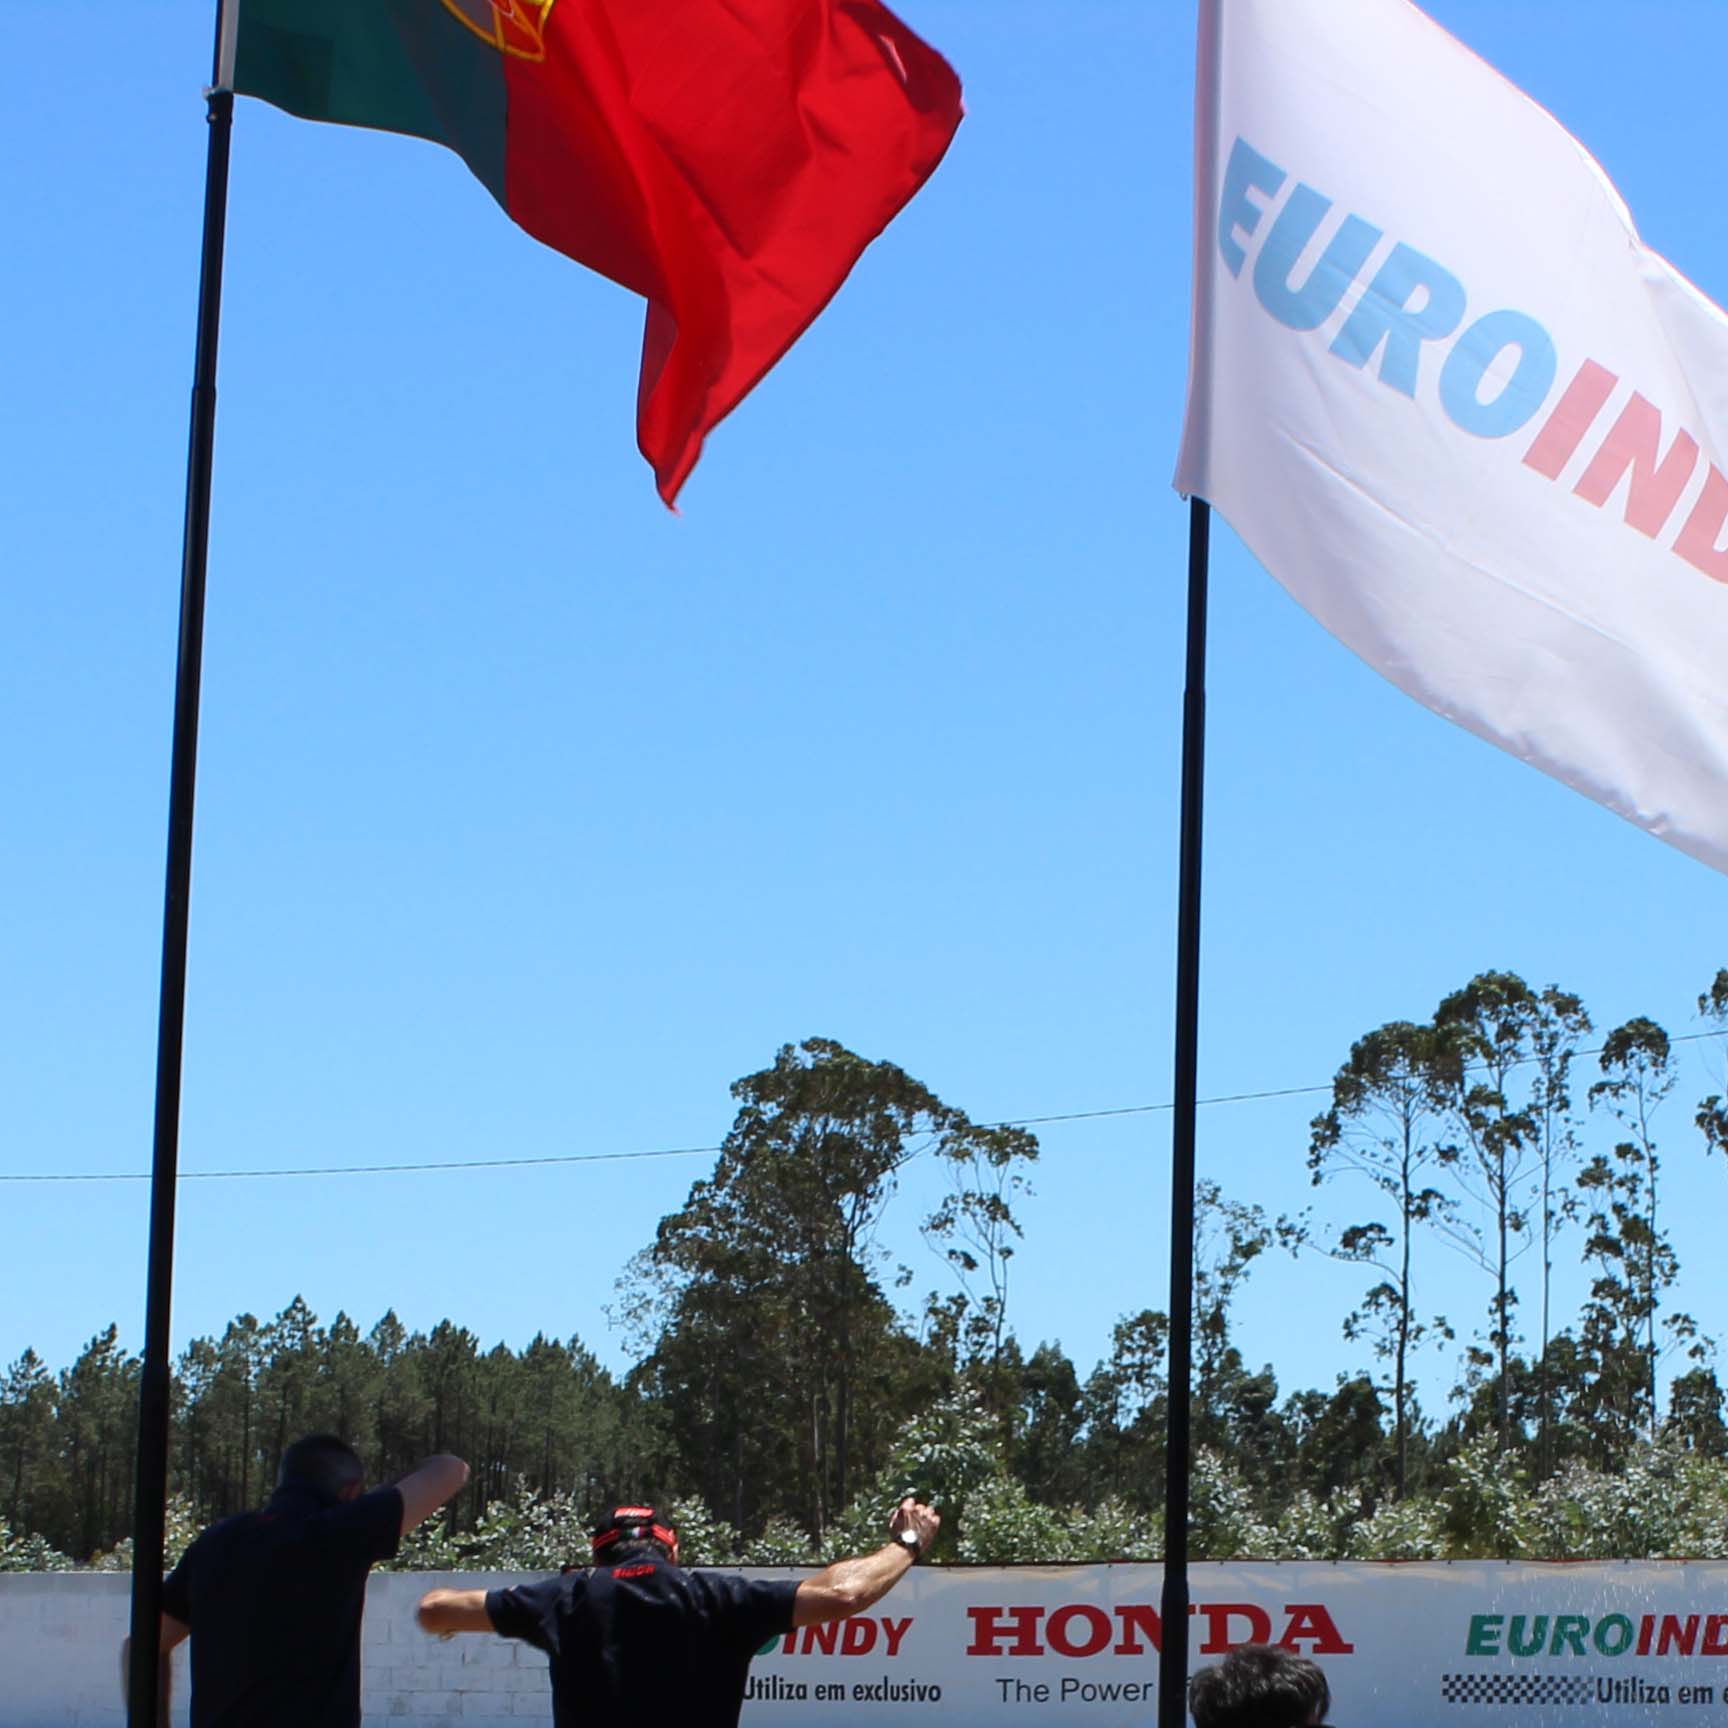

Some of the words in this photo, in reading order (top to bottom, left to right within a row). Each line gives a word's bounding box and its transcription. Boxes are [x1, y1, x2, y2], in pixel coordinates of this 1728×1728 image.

[754, 1617, 915, 1656] INDY
[967, 1603, 1354, 1657] HONDA
[742, 1675, 807, 1701] Utiliza
[814, 1682, 845, 1701] em
[852, 1675, 942, 1702] exclusivo
[997, 1678, 1052, 1702] The
[1061, 1678, 1153, 1703] Power
[1596, 1677, 1671, 1706] Utiliza
[1677, 1684, 1715, 1706] em
